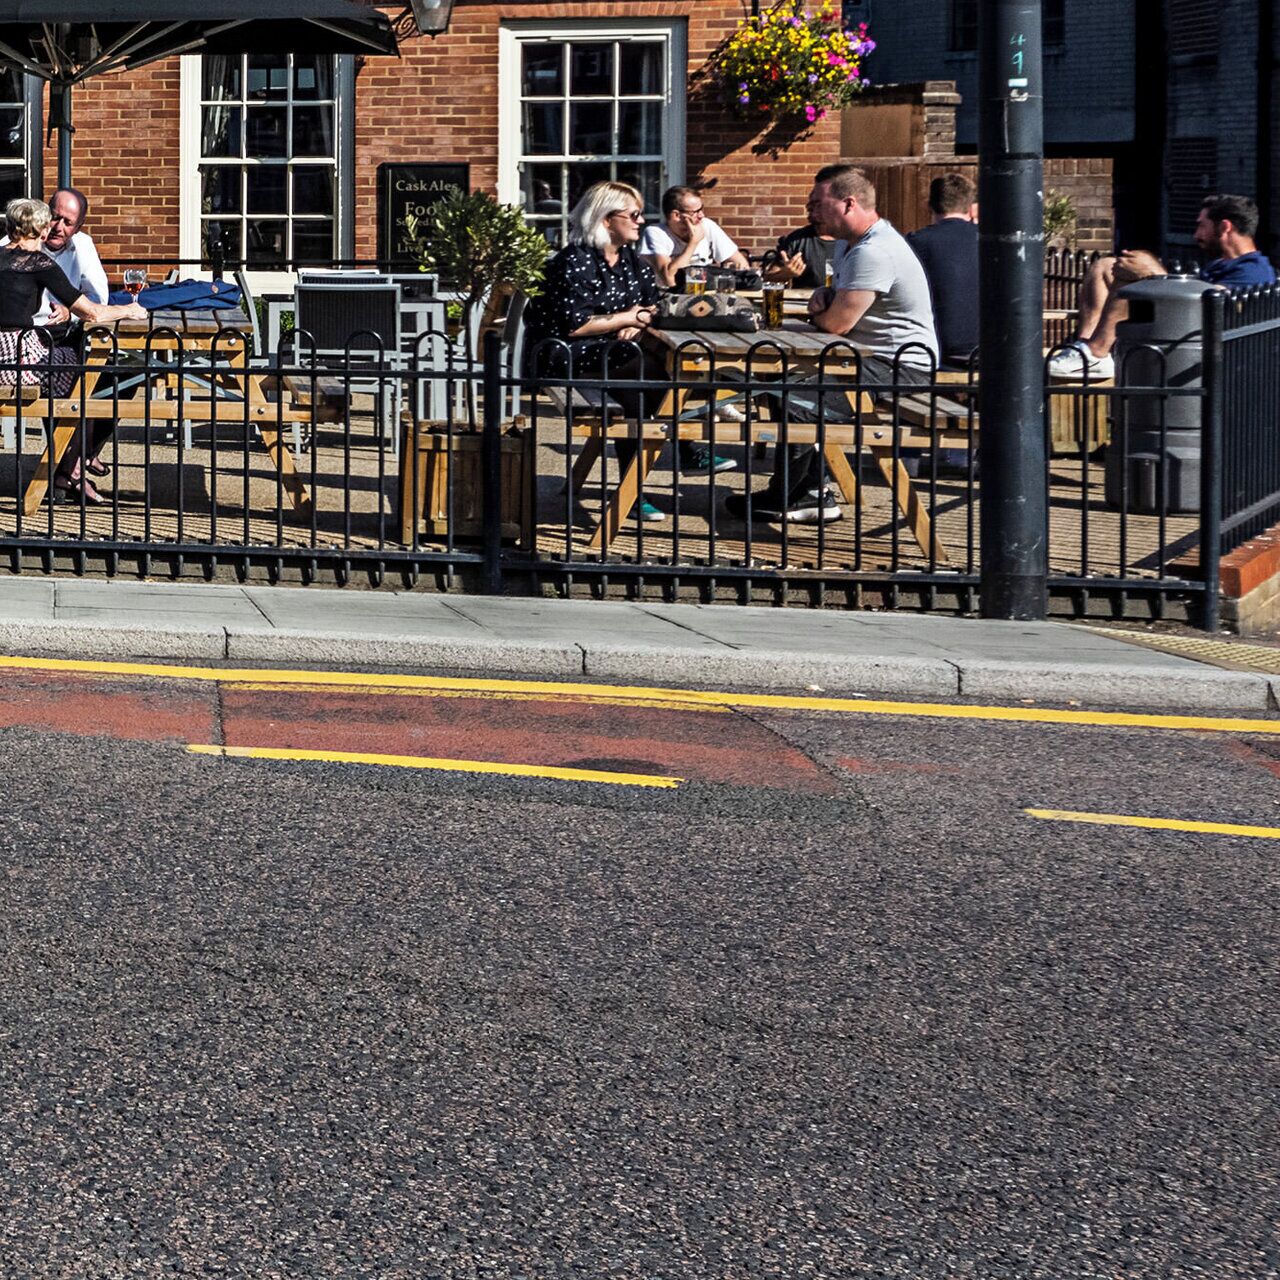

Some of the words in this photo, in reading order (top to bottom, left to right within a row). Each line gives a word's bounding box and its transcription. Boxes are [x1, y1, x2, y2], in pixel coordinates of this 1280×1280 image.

[396, 179, 428, 191] Cask
[429, 180, 458, 191] Ales
[405, 202, 437, 216] Foo
